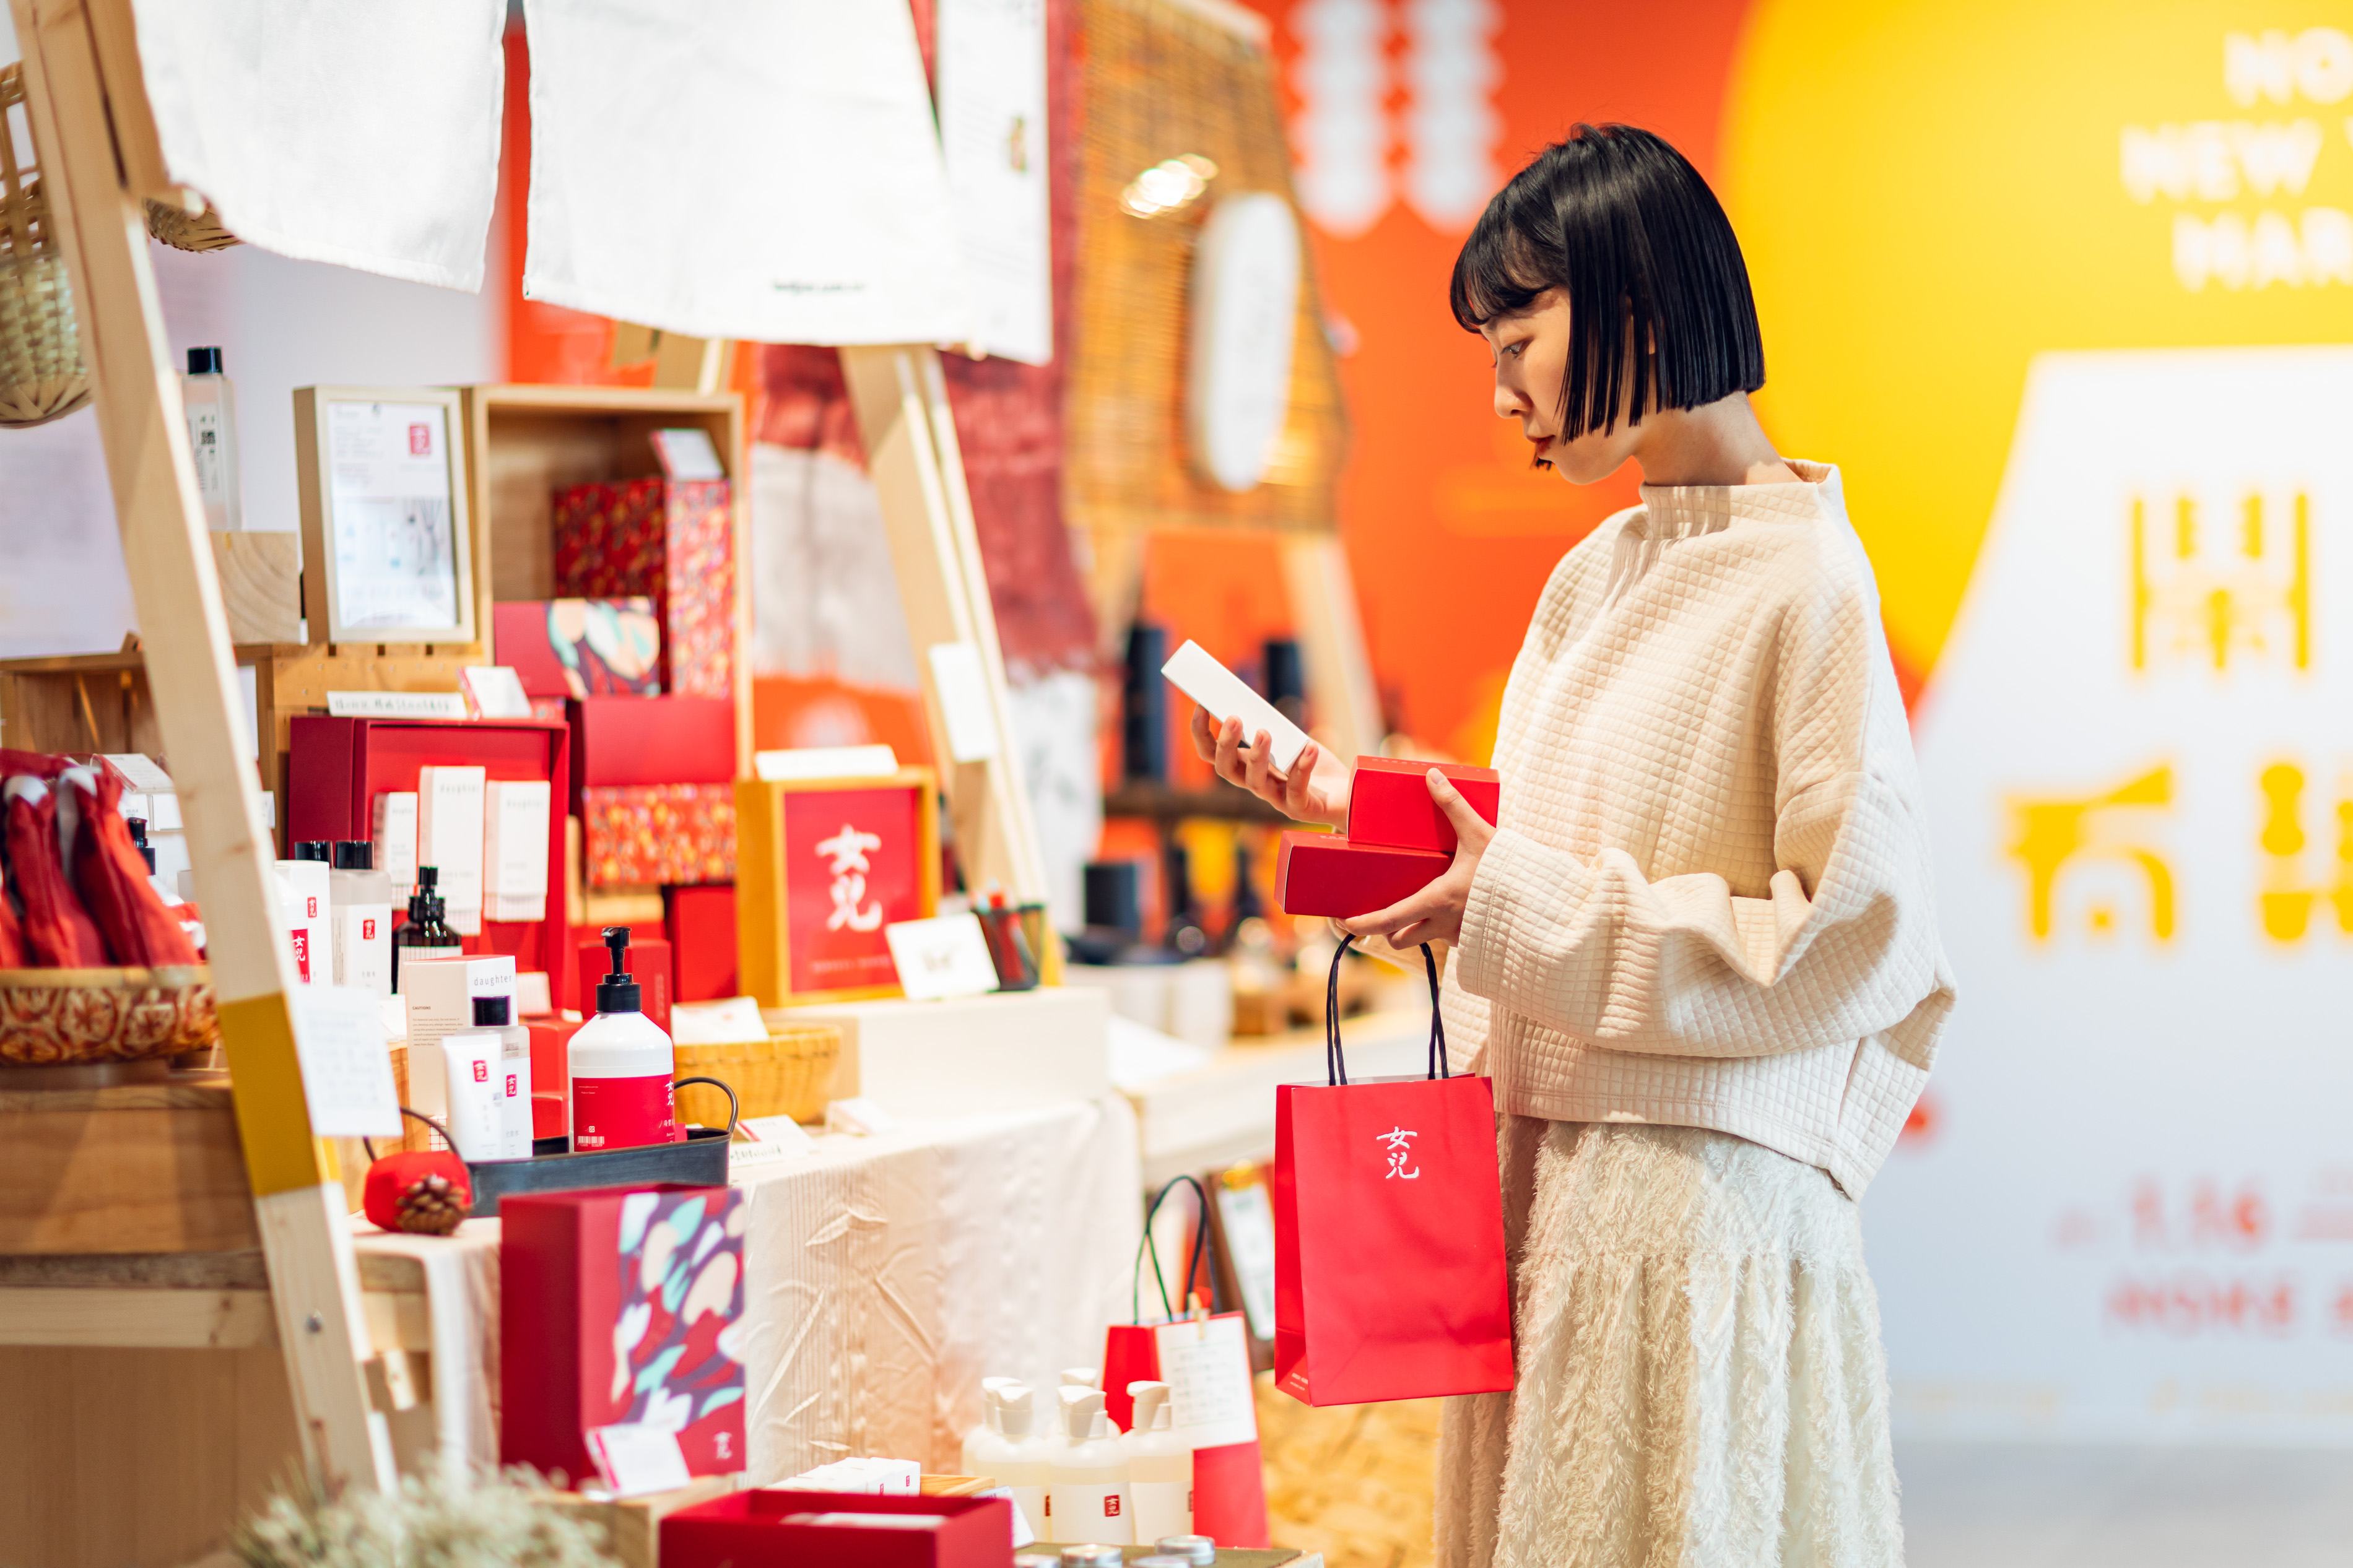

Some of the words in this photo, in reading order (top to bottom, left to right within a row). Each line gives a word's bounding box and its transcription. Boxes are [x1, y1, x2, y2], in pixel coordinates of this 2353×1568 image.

[2121, 119, 2322, 203] NEW
[292, 936, 305, 961] 女兒
[474, 975, 511, 986] daughter
[1376, 1126, 1419, 1179] 女兒
